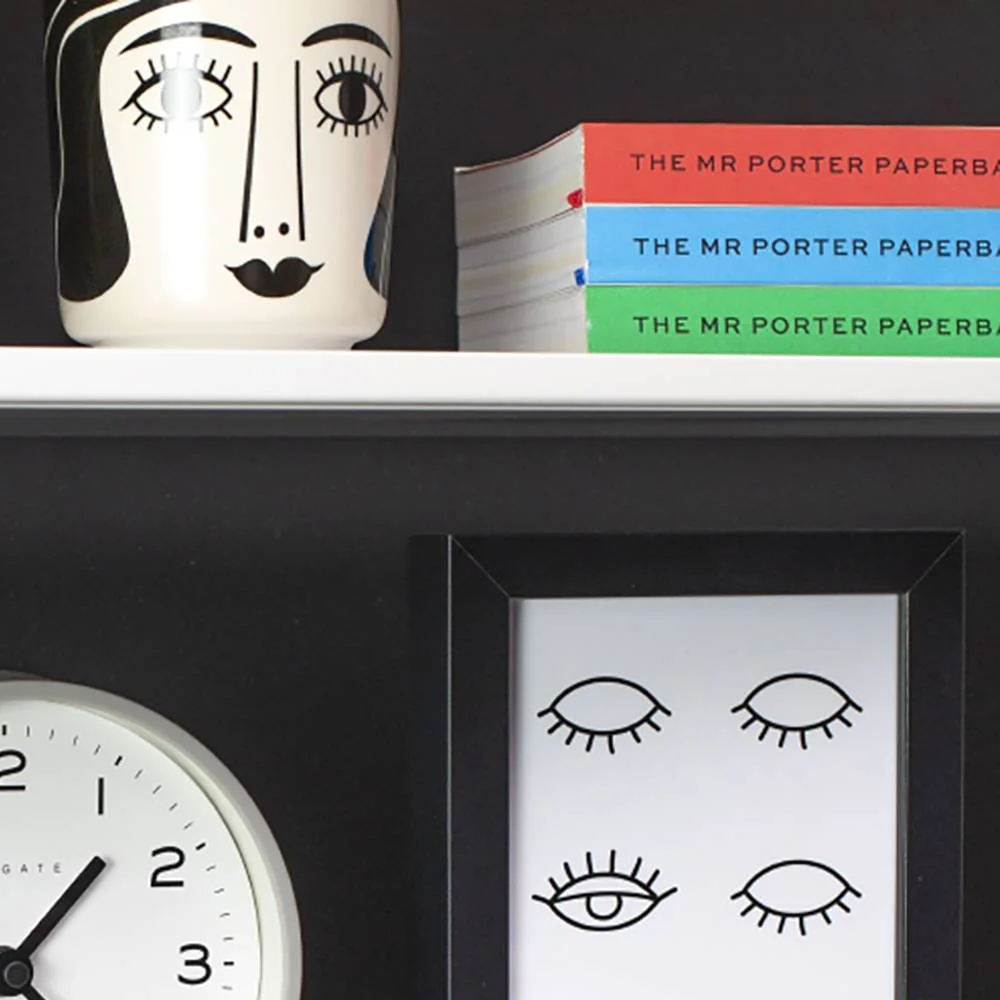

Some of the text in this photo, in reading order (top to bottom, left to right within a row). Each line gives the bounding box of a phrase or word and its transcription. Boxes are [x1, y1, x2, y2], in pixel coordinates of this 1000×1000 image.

[630, 154, 686, 172] THE
[697, 155, 737, 172] MR
[748, 155, 864, 174] PORTER
[633, 237, 1000, 258] THE MR PORTER PAPERB
[633, 316, 1000, 337] THE MR PORTER PAPERB
[98, 777, 104, 815] 1
[150, 846, 185, 888] 2
[177, 943, 212, 985] 3
